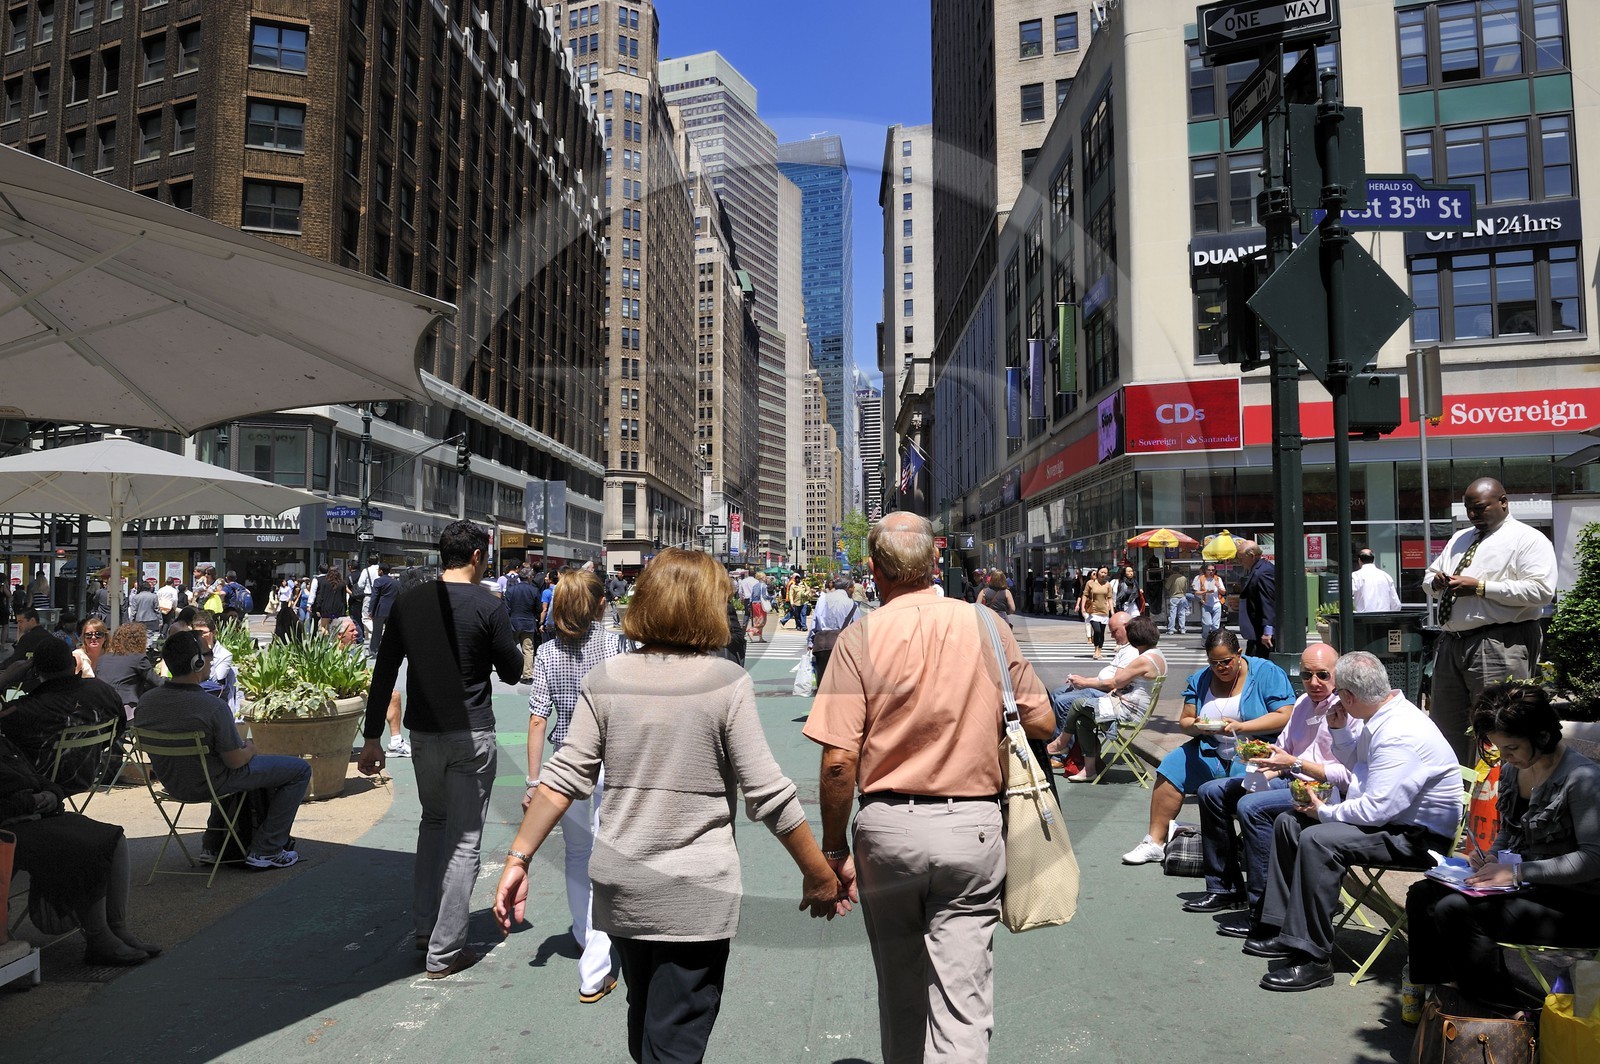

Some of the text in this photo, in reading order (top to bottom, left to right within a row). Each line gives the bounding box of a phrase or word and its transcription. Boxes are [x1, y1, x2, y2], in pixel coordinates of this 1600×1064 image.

[1225, 0, 1321, 31] ONE WAY
[1235, 76, 1271, 123] ONE WAY
[1402, 183, 1413, 191] SQ
[1389, 195, 1430, 218] 35th
[1438, 196, 1462, 218] St
[1155, 403, 1205, 424] CDs
[1450, 400, 1587, 427] Sovereign
[1138, 437, 1177, 447] Sovereign
[1198, 434, 1239, 443] Santander
